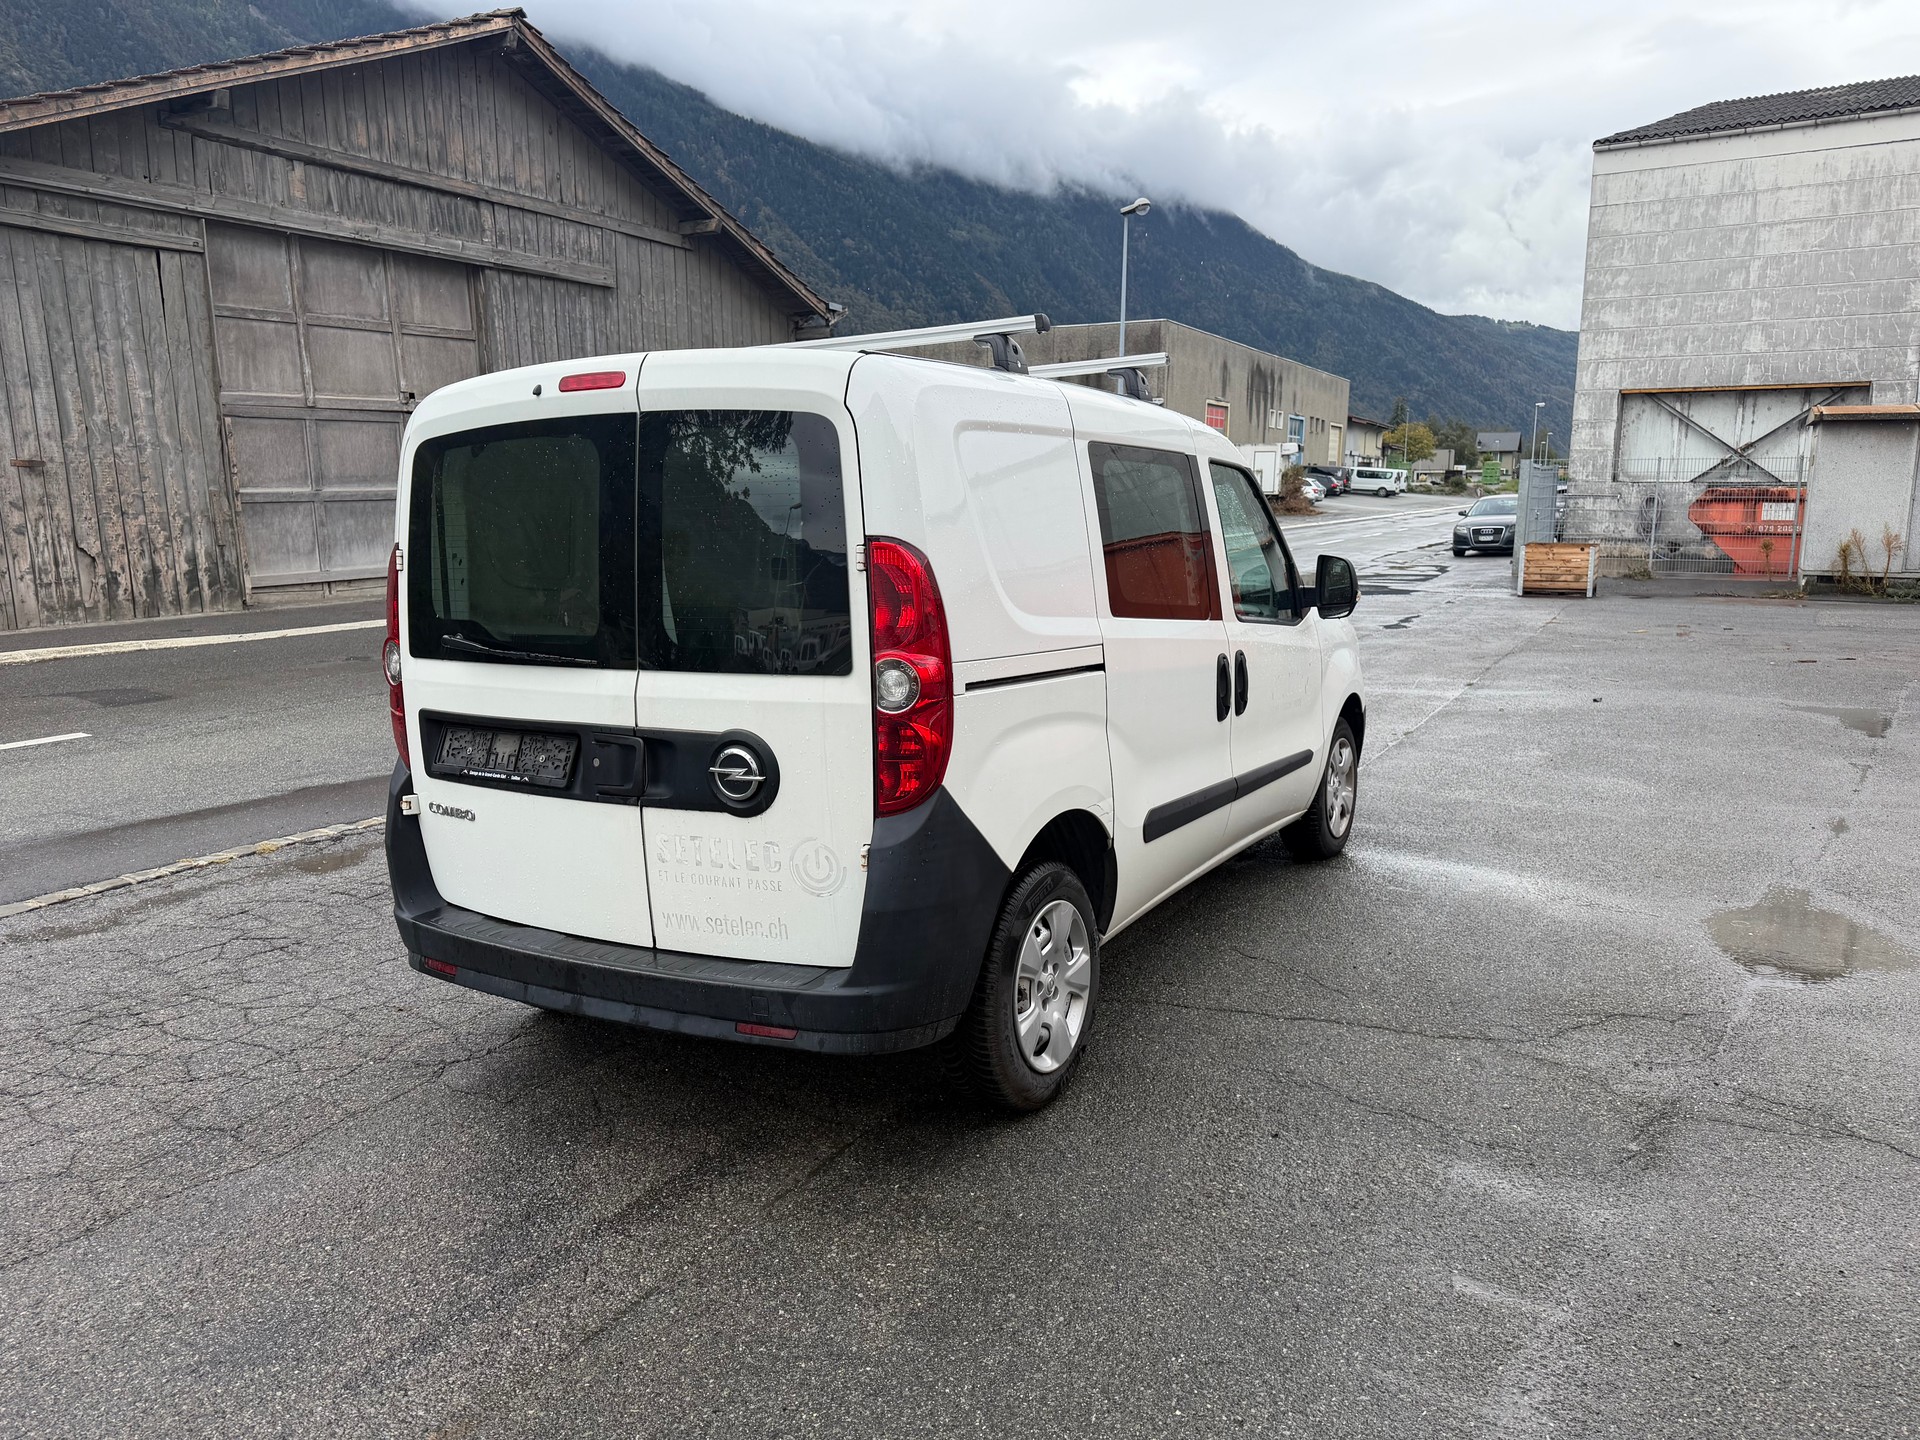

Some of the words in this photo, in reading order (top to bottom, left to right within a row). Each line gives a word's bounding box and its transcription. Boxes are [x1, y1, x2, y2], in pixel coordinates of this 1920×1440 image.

[429, 802, 476, 821] COMBO
[656, 833, 782, 872] SETELEC
[658, 870, 669, 882] ET
[674, 872, 686, 883] LE
[690, 874, 741, 889] COURANT
[747, 878, 783, 892] PASSE
[662, 911, 789, 940] www.setelec.ch
